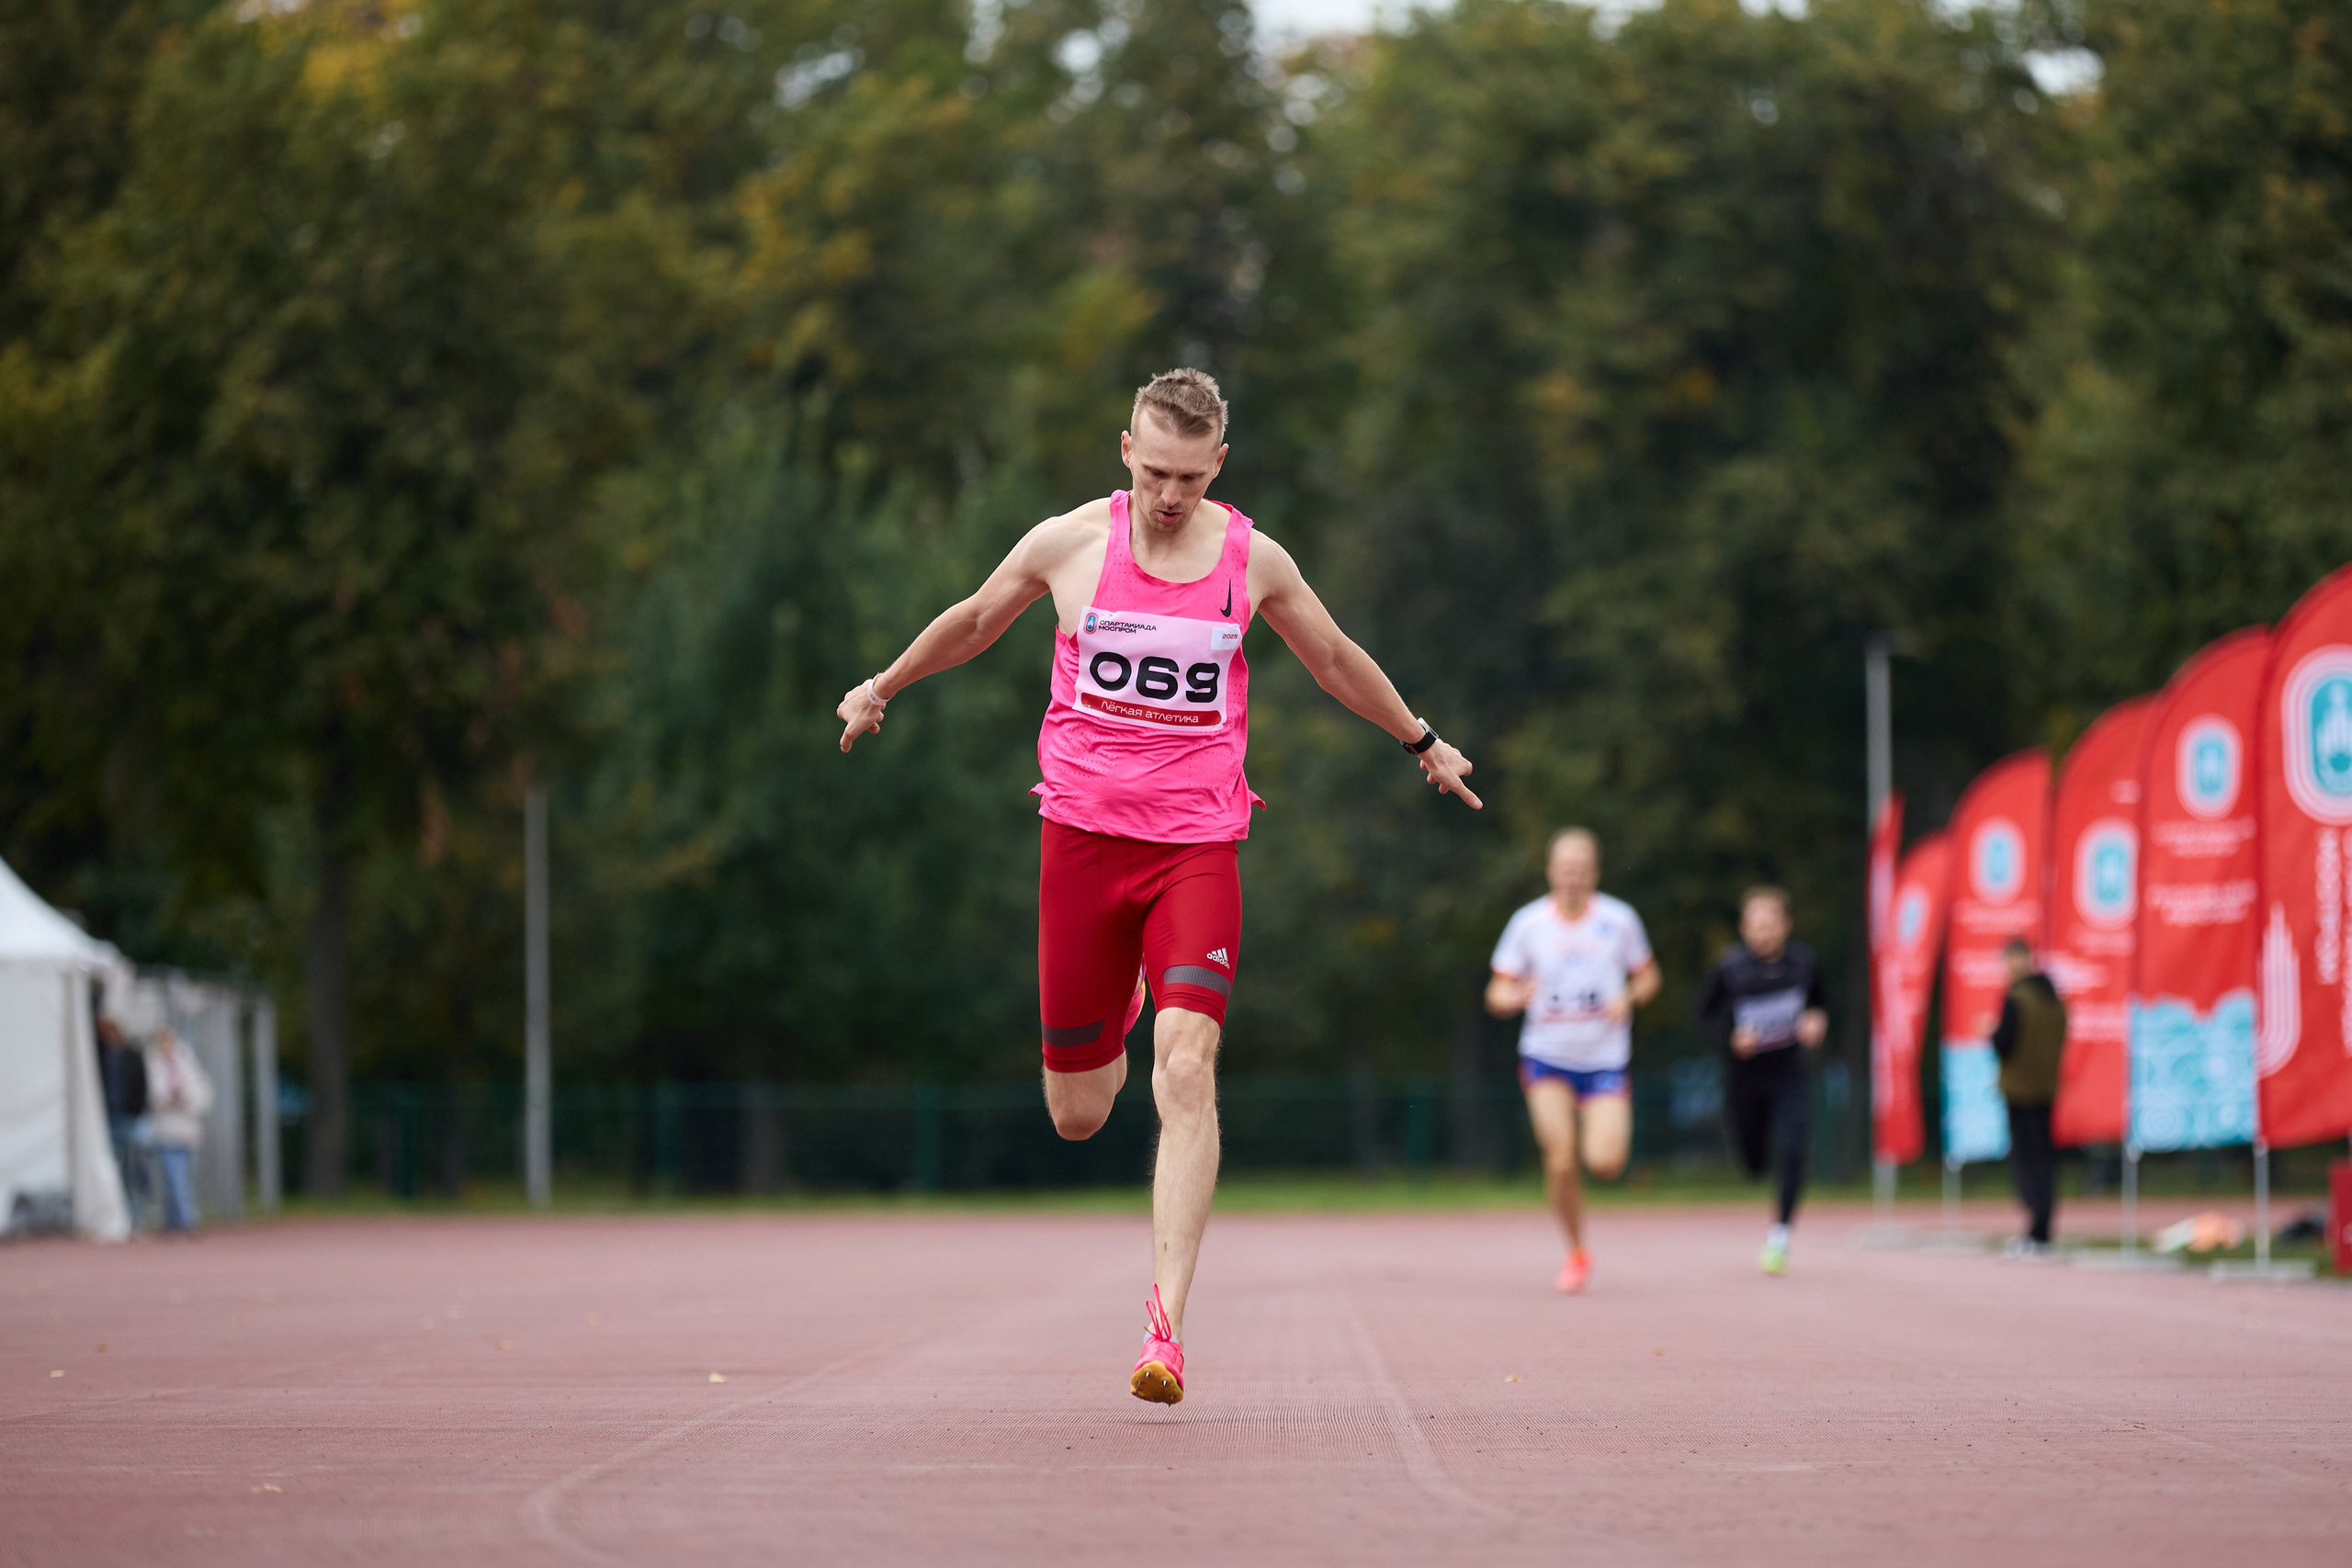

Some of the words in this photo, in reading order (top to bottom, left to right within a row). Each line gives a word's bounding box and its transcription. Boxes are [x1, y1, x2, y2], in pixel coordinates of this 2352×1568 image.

[1098, 625, 1136, 634] МОСПРОМ
[1100, 620, 1157, 631] СПАРТАКИАДА
[1090, 651, 1220, 703] 069
[1101, 700, 1143, 716] Лёгкая
[1145, 710, 1199, 723] атлетика
[1206, 953, 1230, 970] adidas
